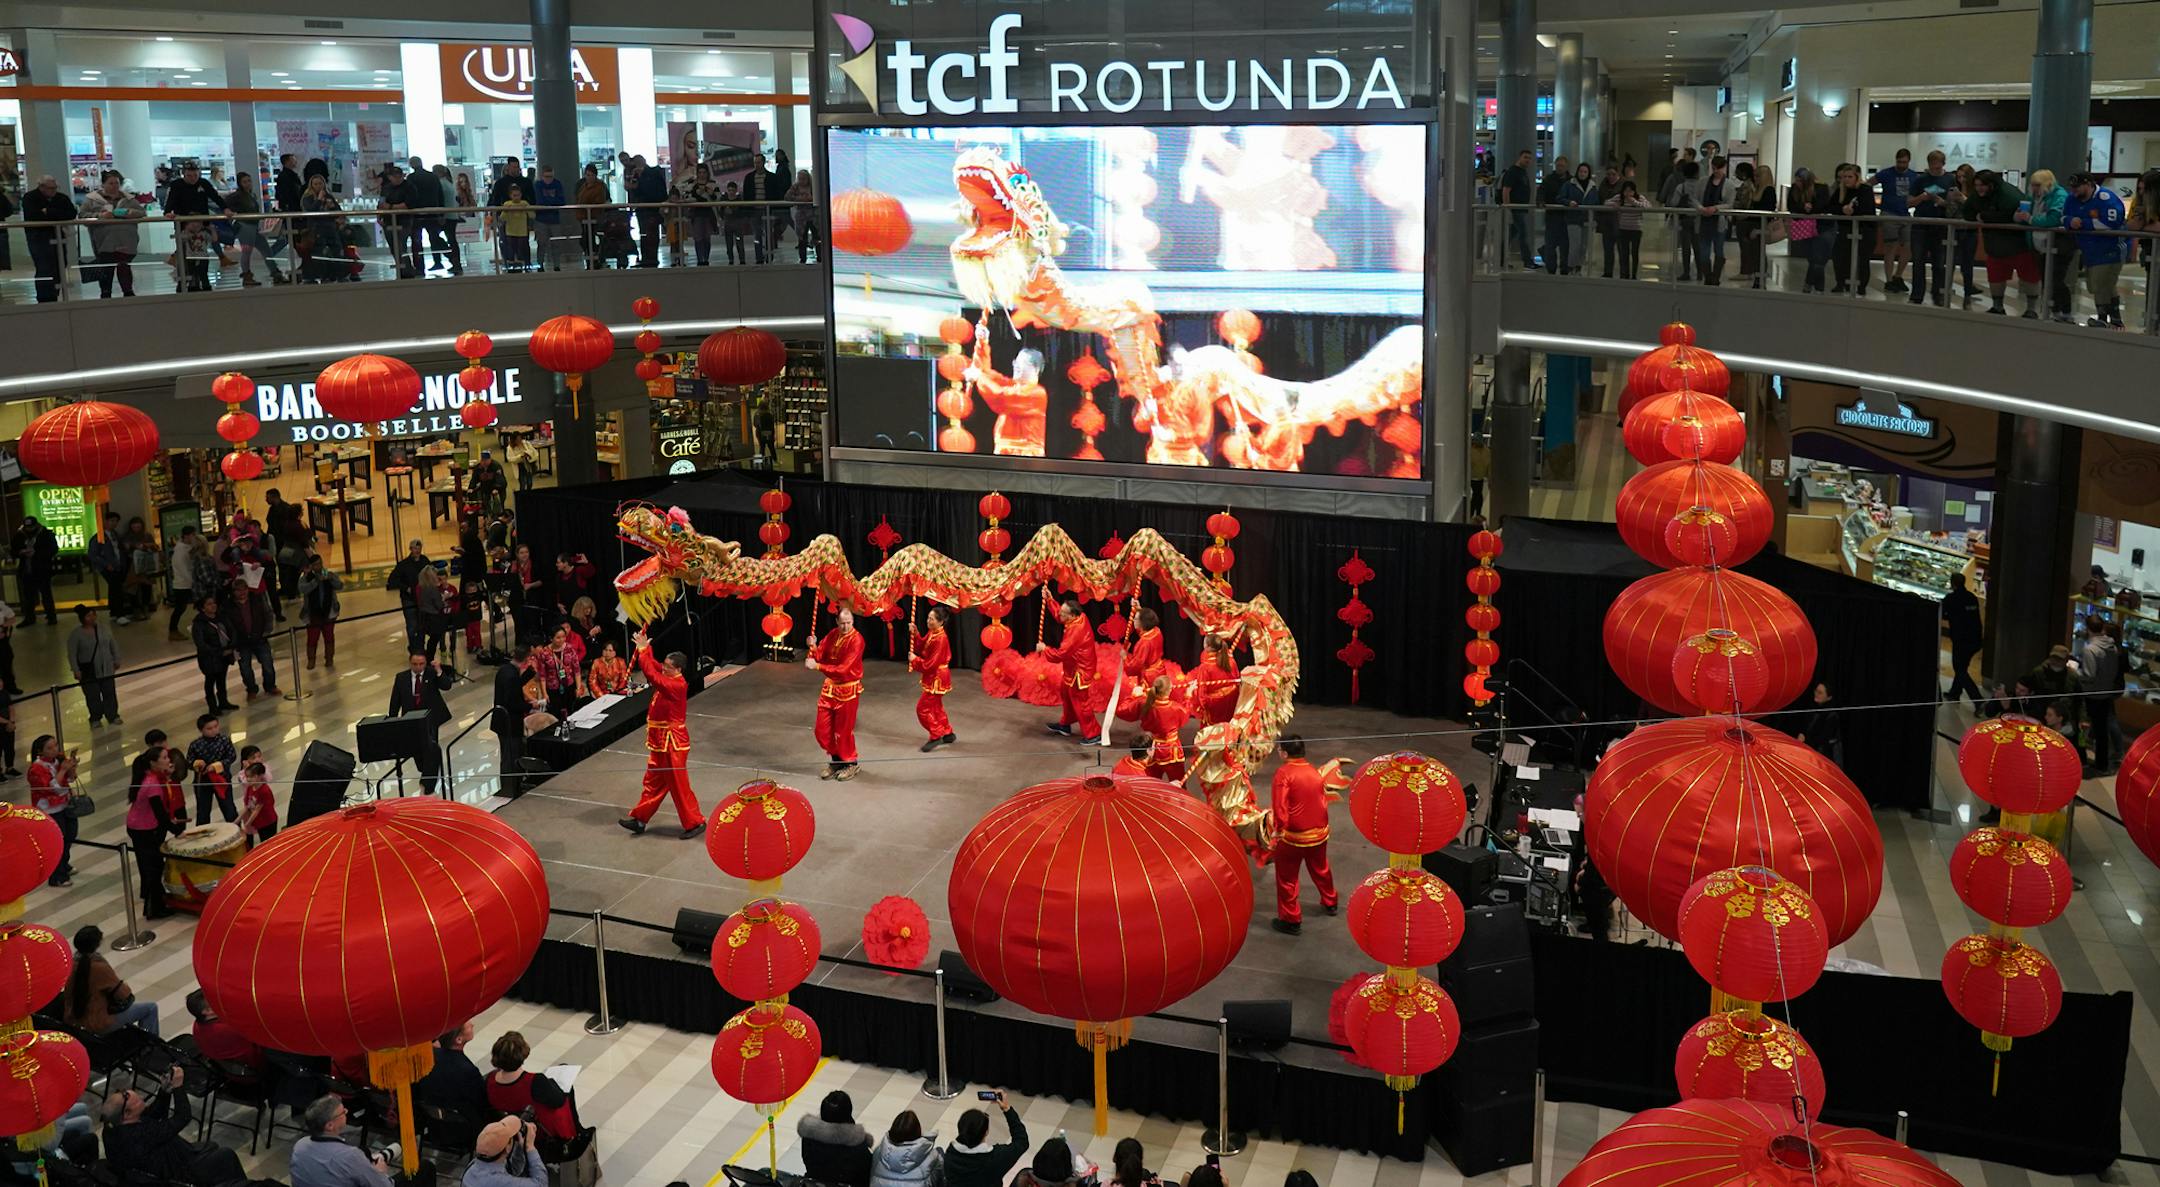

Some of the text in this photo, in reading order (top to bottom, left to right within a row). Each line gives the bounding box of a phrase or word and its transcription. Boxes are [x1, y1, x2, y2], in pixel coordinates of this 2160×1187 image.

[481, 47, 595, 83] ULA
[887, 13, 1408, 116] tcf ROTUNDA
[518, 82, 600, 92] BTY
[1938, 142, 1999, 159] ALES
[2107, 208, 2117, 221] 9
[424, 367, 522, 412] NOLE
[292, 414, 499, 443] BOOKSELLE
[1840, 409, 1889, 429] CHOCOLATE
[1890, 416, 1930, 437] FACTORY
[660, 437, 701, 458] Café
[39, 488, 82, 500] OPEN
